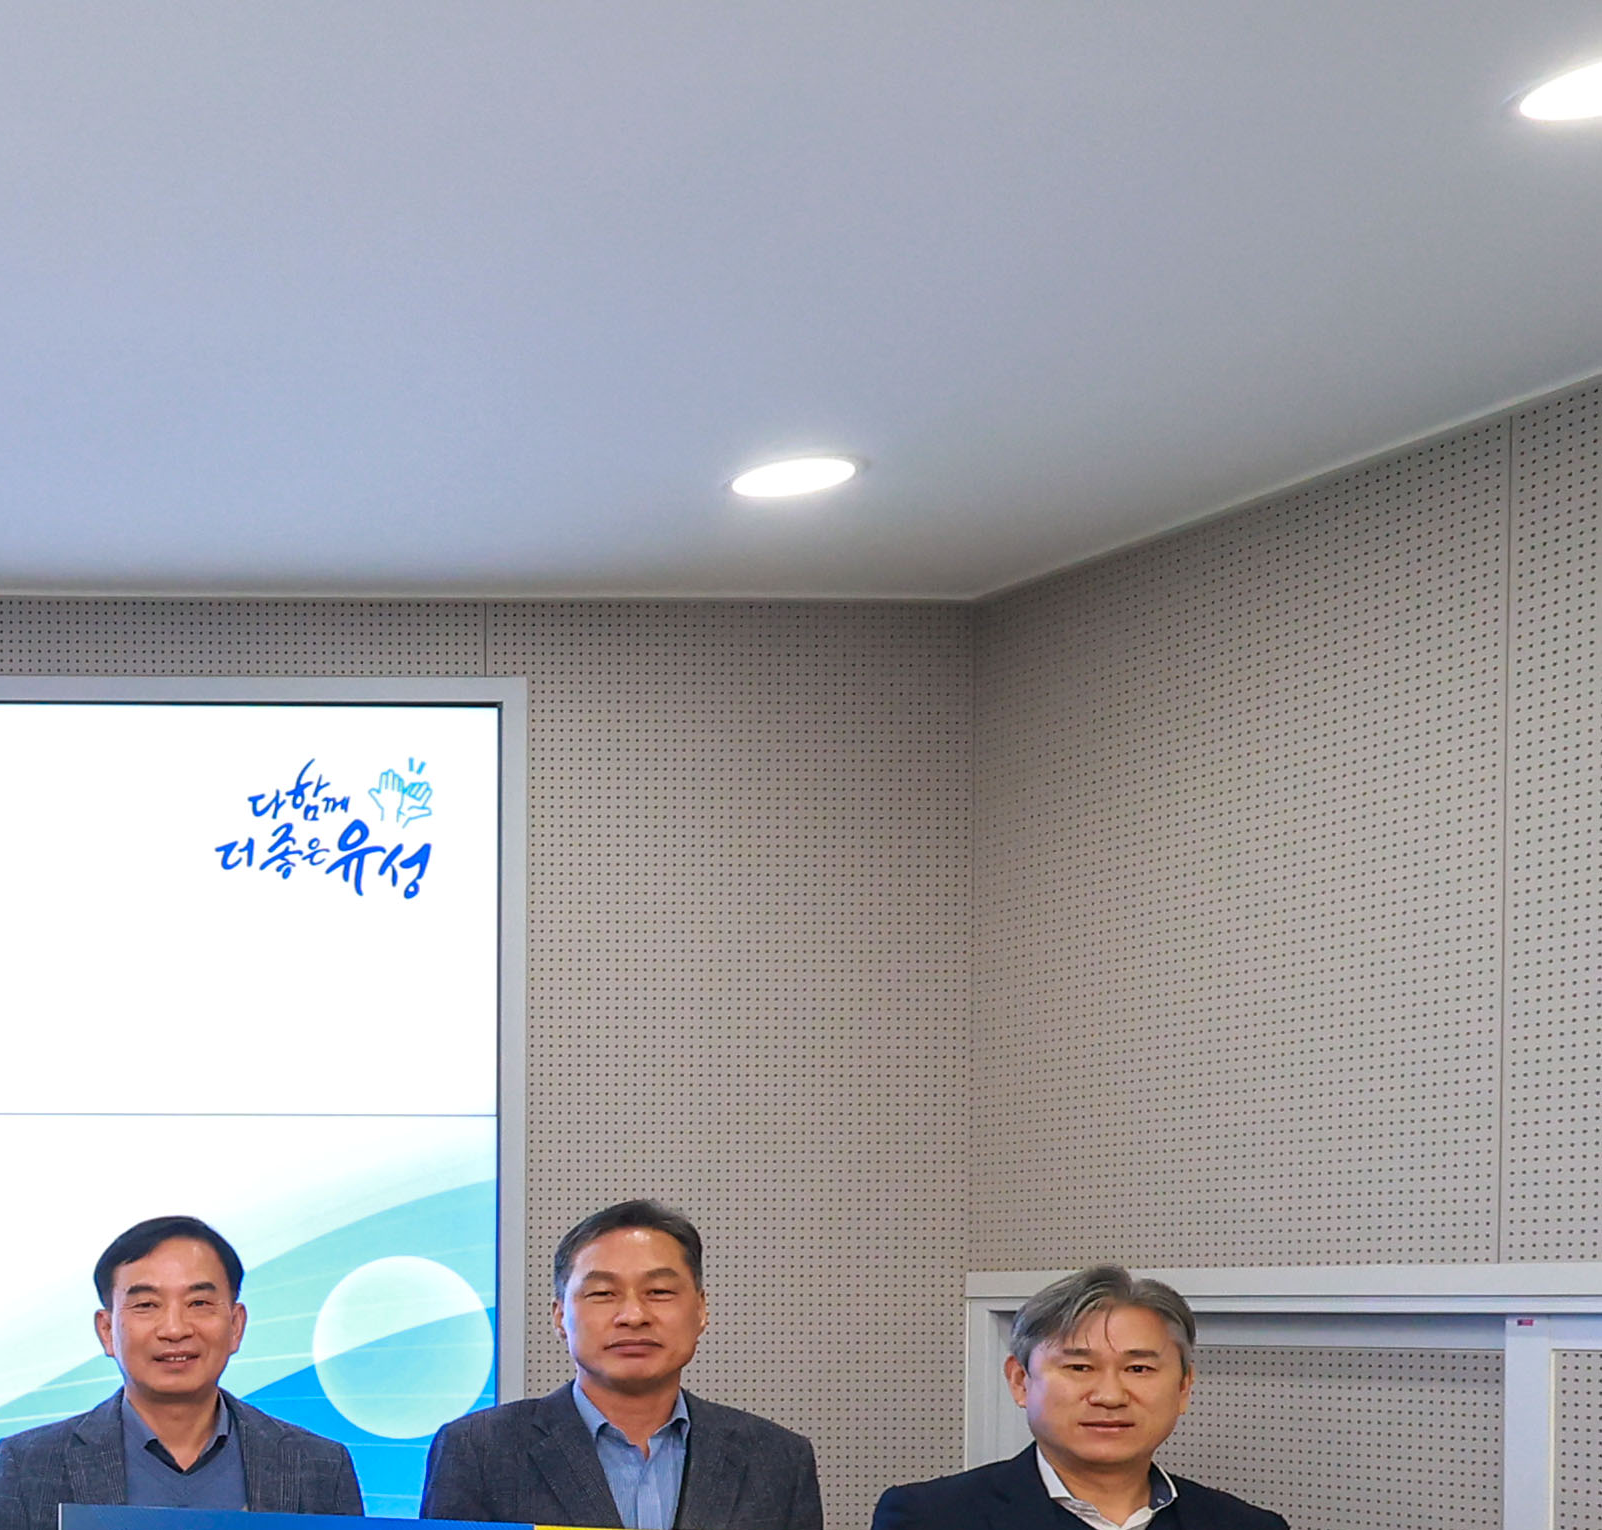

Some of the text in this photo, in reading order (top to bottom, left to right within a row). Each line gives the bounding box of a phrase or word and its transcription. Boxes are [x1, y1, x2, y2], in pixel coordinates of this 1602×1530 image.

[247, 758, 351, 821] 다함께
[214, 819, 432, 899] 더 좋은 유성
